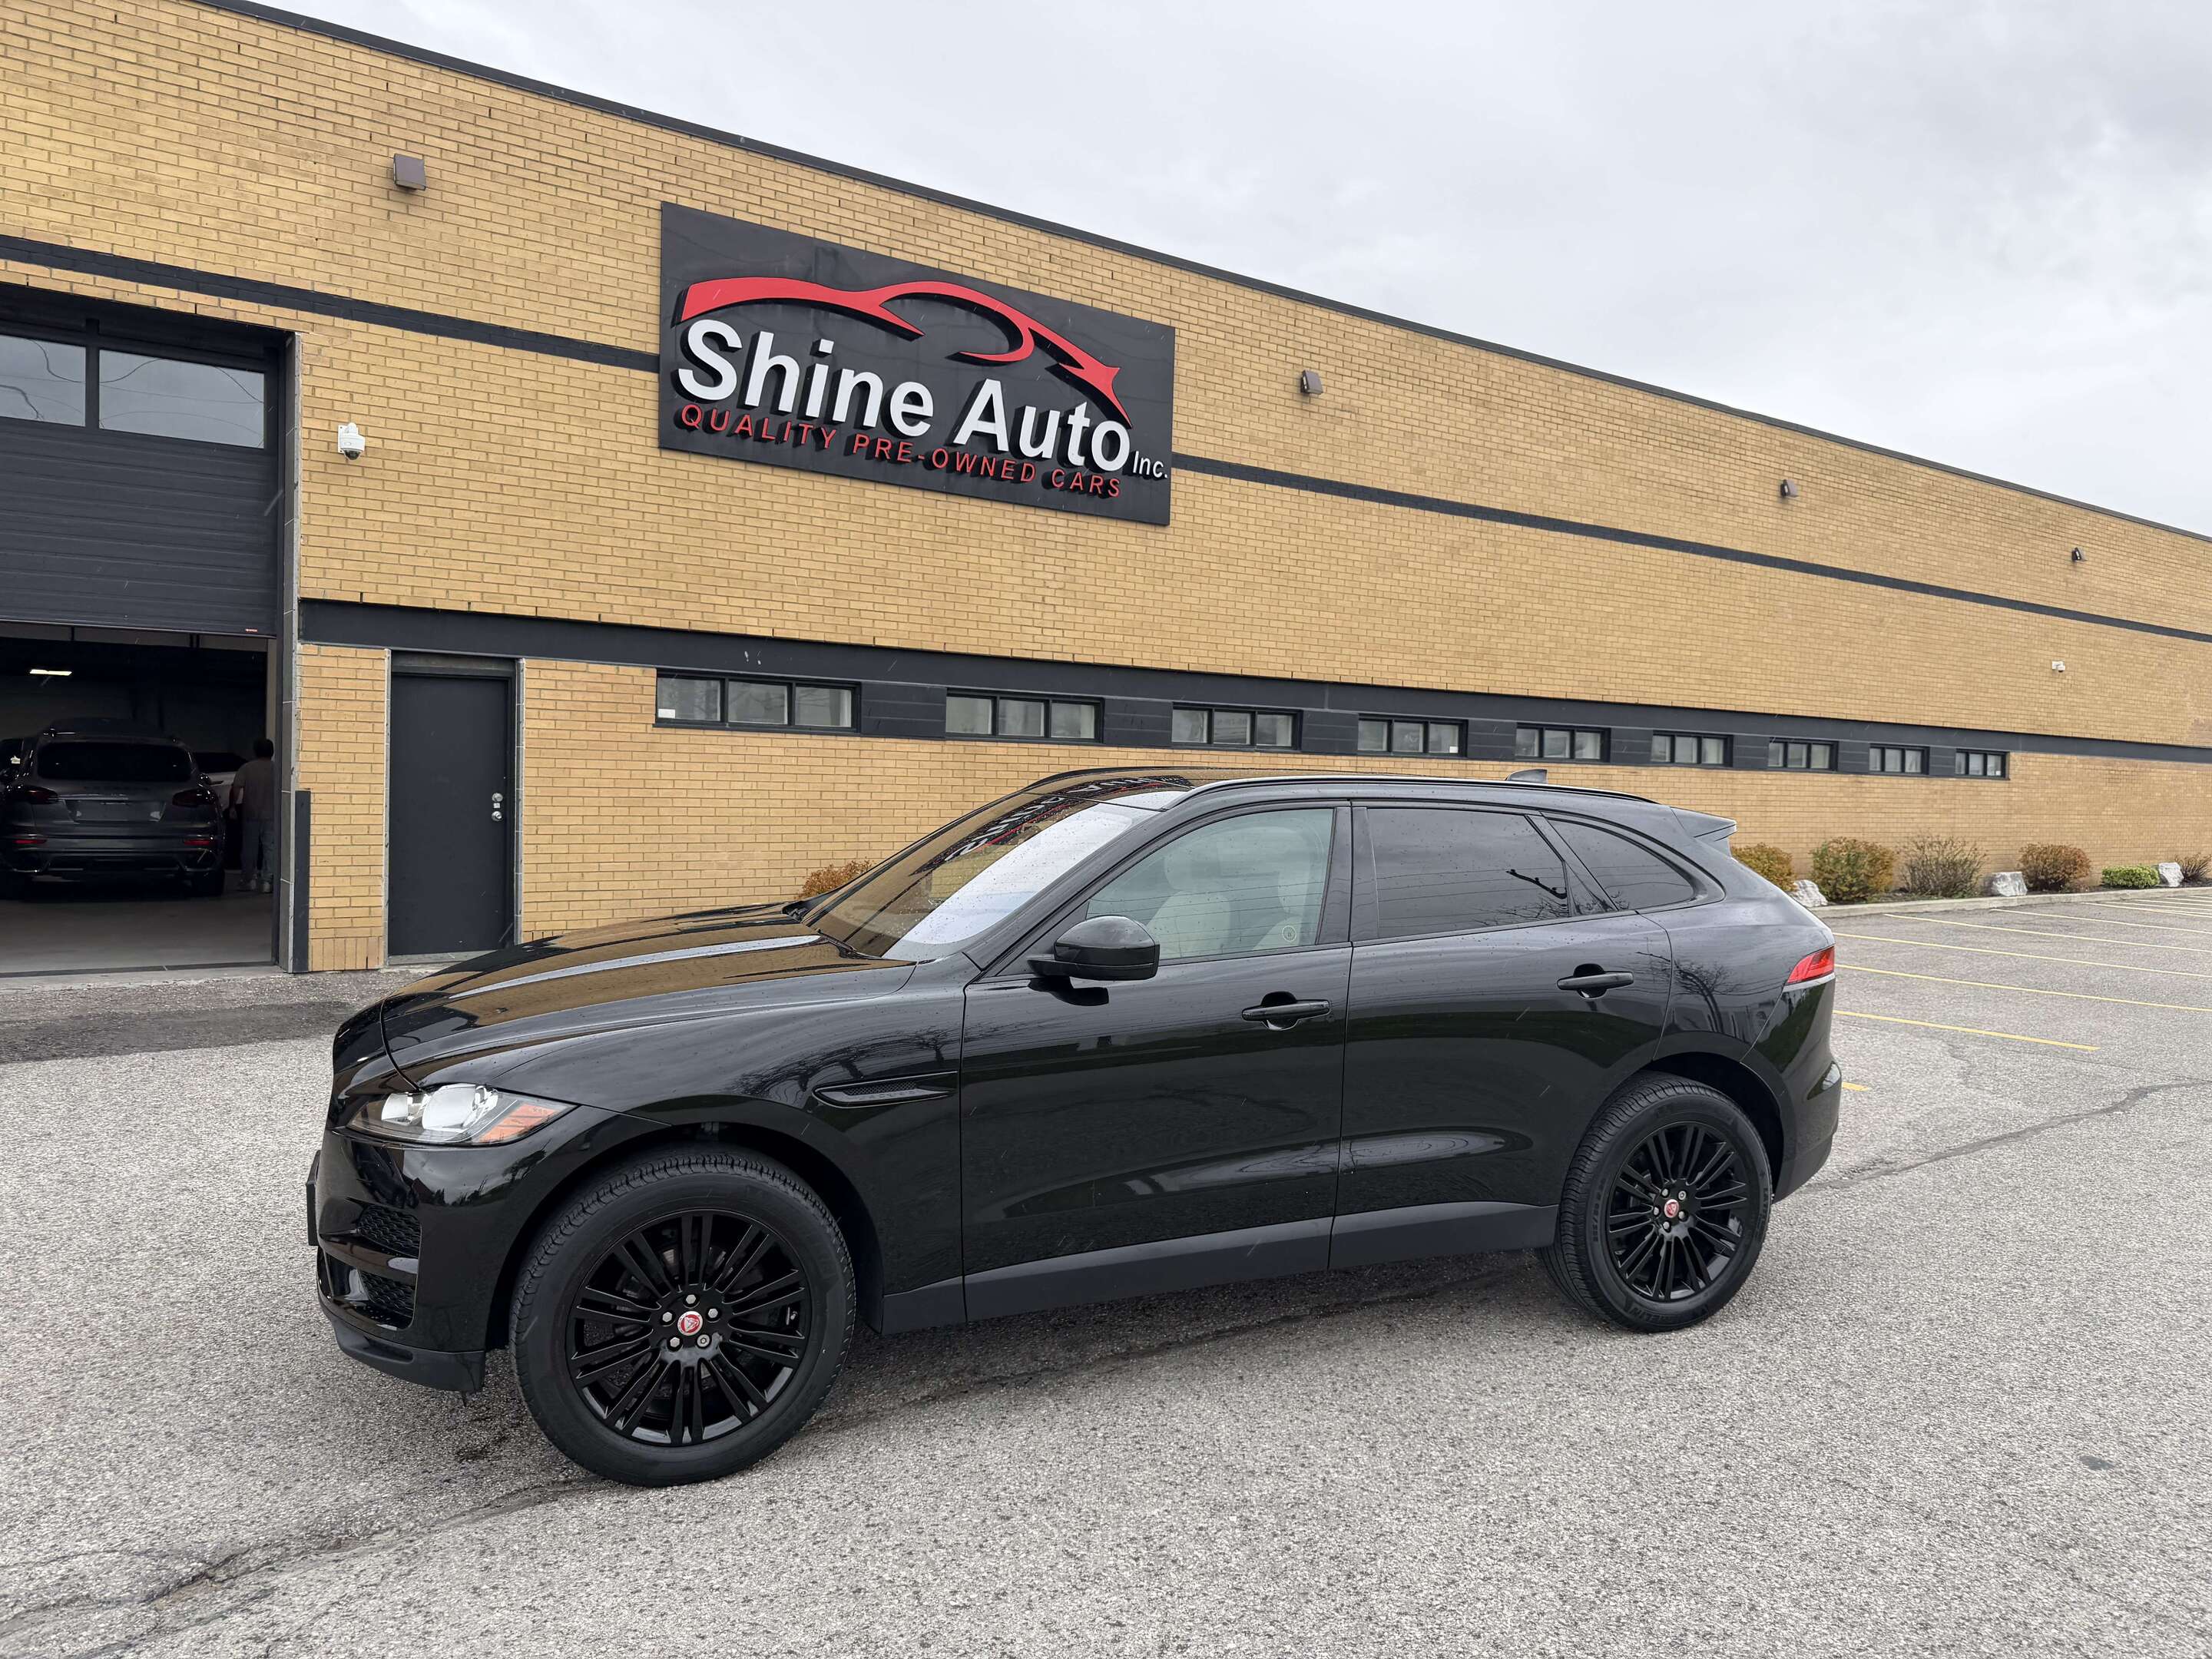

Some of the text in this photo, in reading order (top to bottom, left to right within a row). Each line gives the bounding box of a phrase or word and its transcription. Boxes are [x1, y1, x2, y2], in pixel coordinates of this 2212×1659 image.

[677, 319, 1168, 478] Shine Auto Inc.
[680, 404, 1121, 498] QUALITY PRE-OWNED CARS
